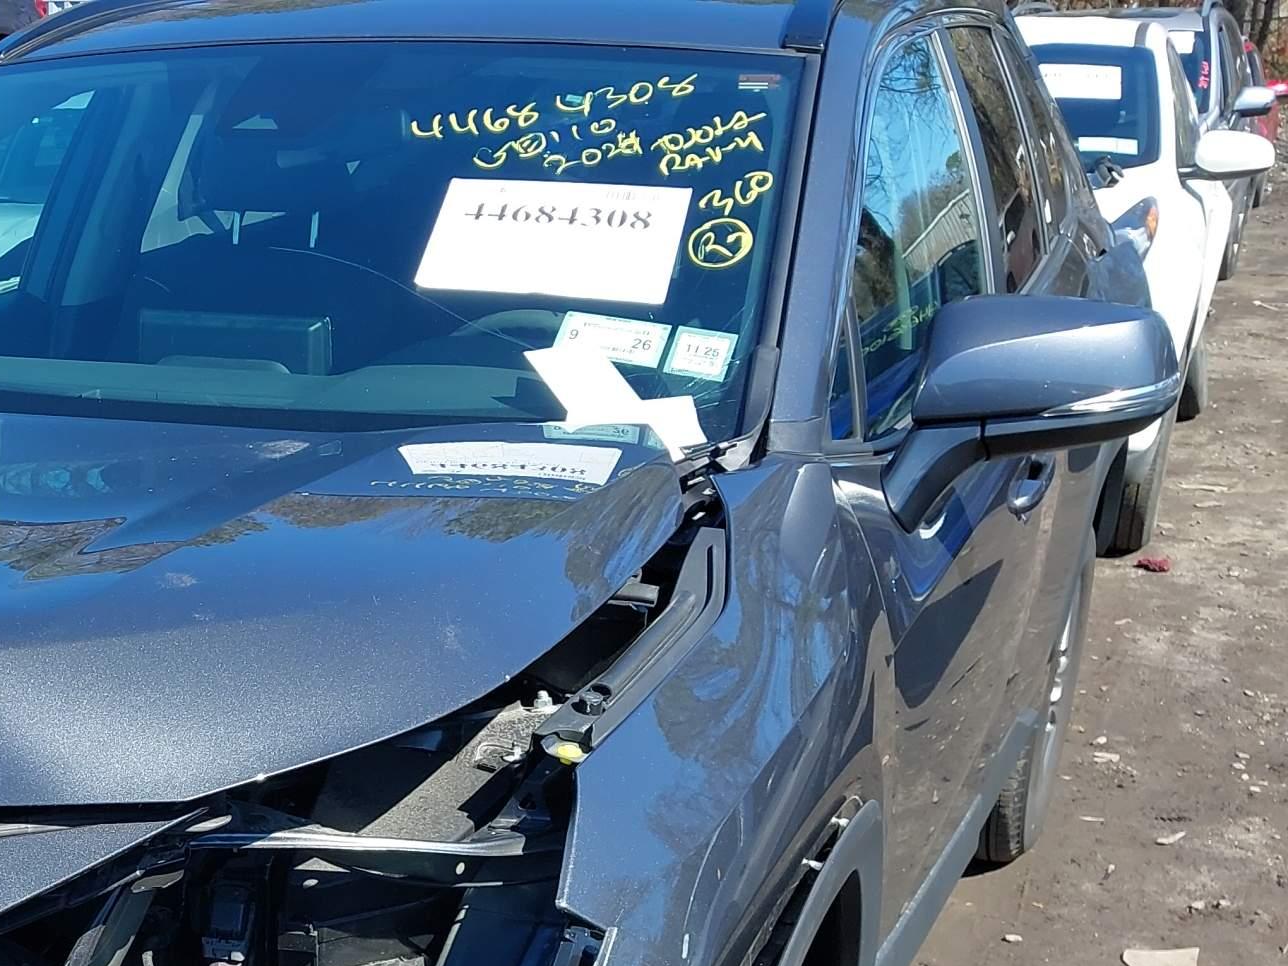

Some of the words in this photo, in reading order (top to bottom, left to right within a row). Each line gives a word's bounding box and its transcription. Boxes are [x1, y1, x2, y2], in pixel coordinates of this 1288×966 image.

[555, 74, 699, 116] 4308
[464, 202, 653, 230] 44684308
[568, 328, 579, 341] 9
[631, 337, 653, 352] 26
